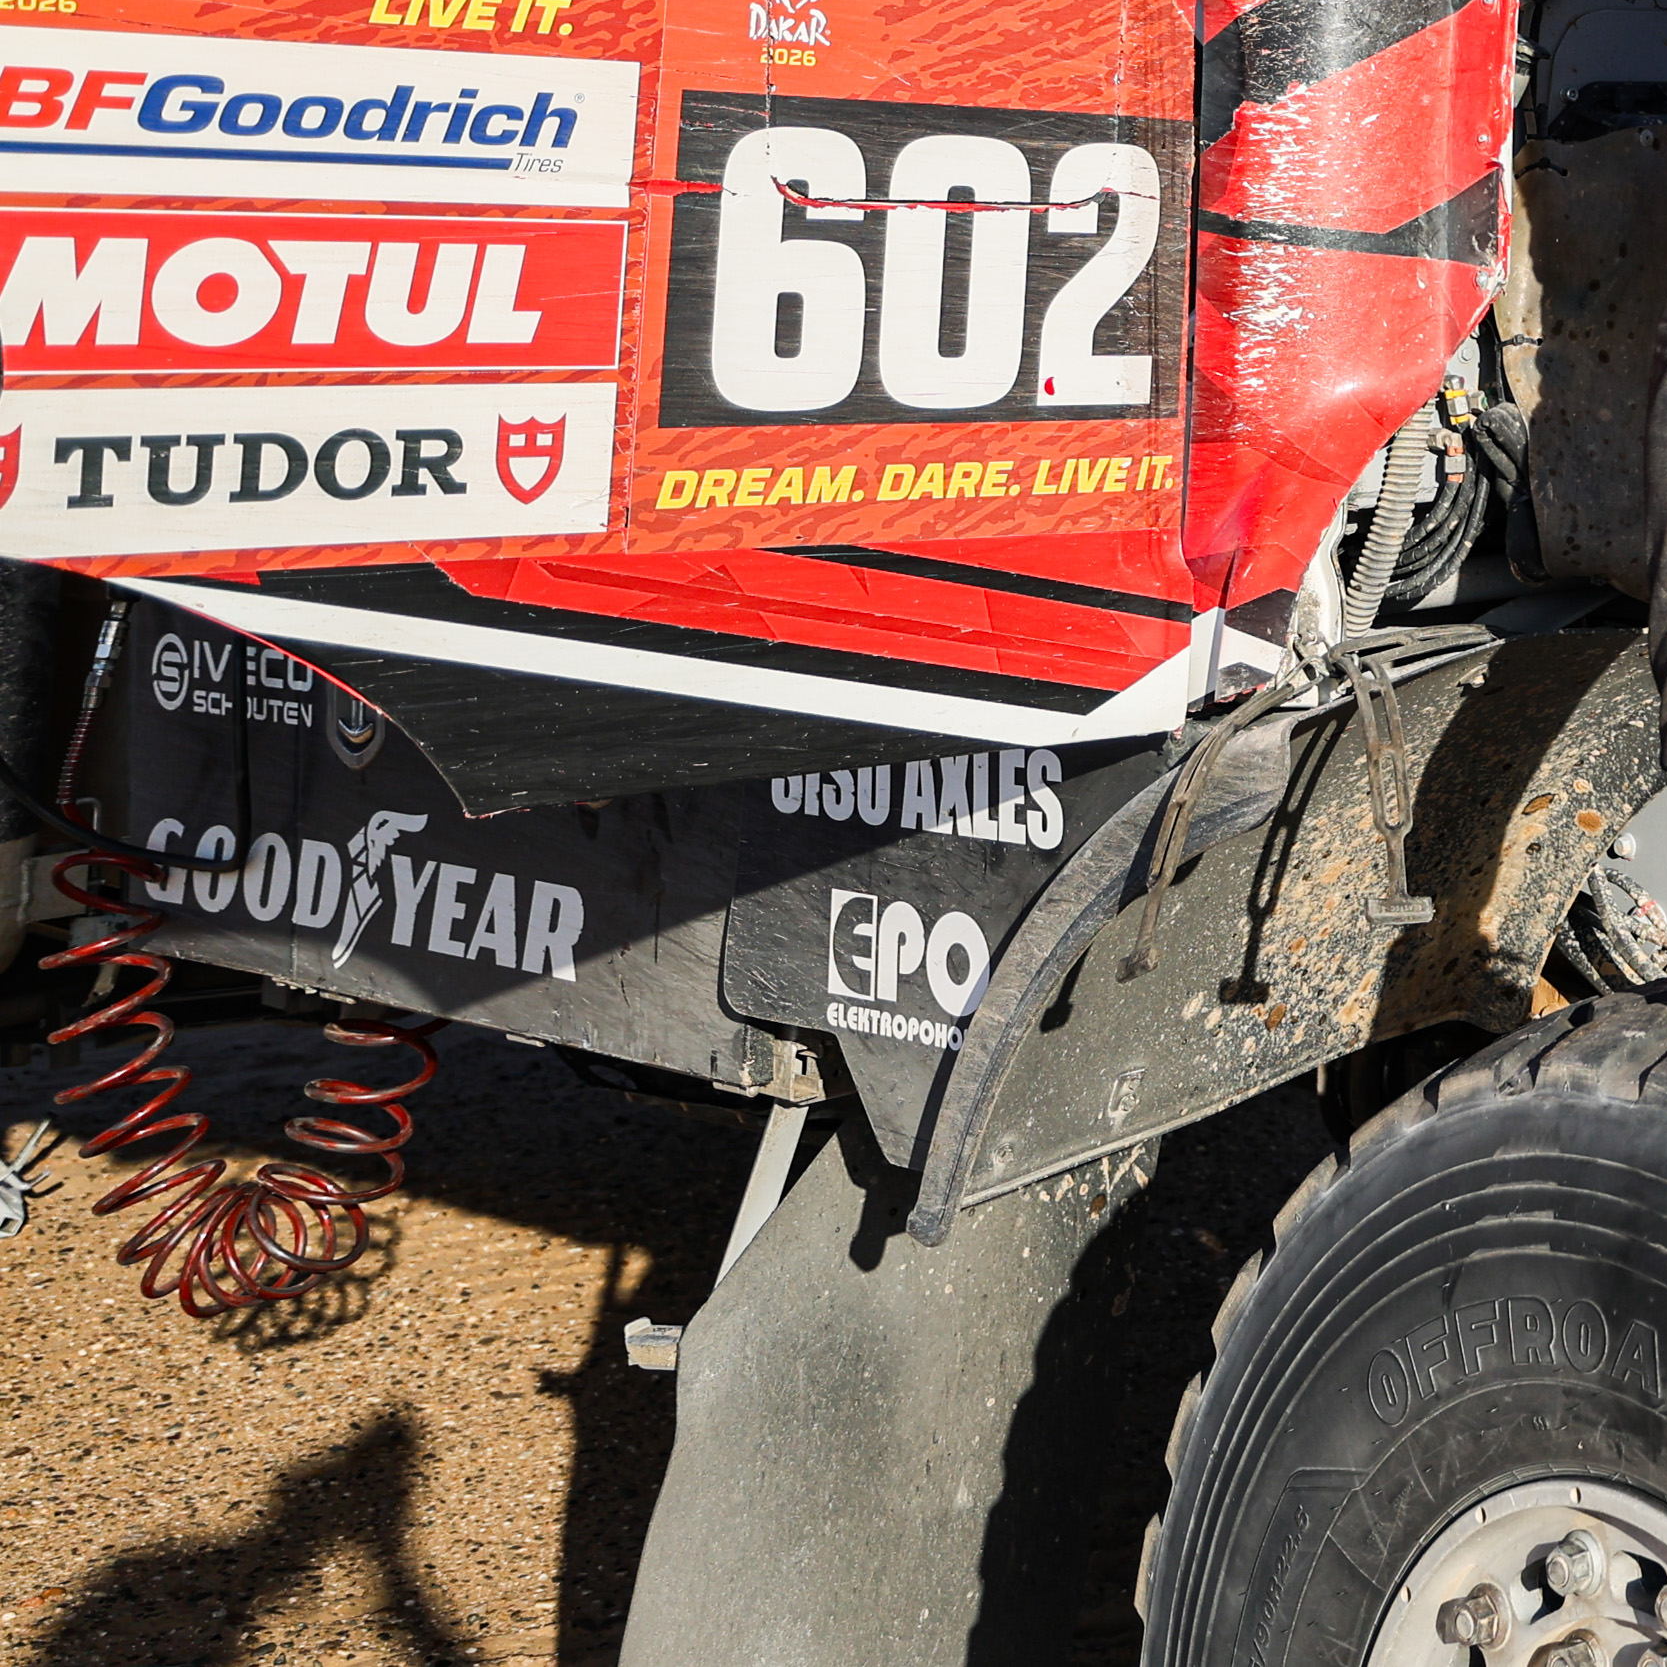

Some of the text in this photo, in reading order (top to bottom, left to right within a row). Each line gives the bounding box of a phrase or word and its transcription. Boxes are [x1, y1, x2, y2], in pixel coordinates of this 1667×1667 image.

[749, 2, 829, 47] DAKAR
[760, 47, 817, 67] 2026
[0, 65, 578, 149] BFGoodrich
[514, 152, 563, 173] Tires
[2, 237, 542, 347] MOTUL
[711, 126, 1162, 412] 602
[53, 426, 468, 510] TUDOR
[656, 454, 1176, 510] DREAM. DARE. LIVE IT.
[901, 748, 1065, 851] AXLES
[827, 887, 991, 1017] EPO
[826, 1006, 970, 1052] ELEKTROPOHO
